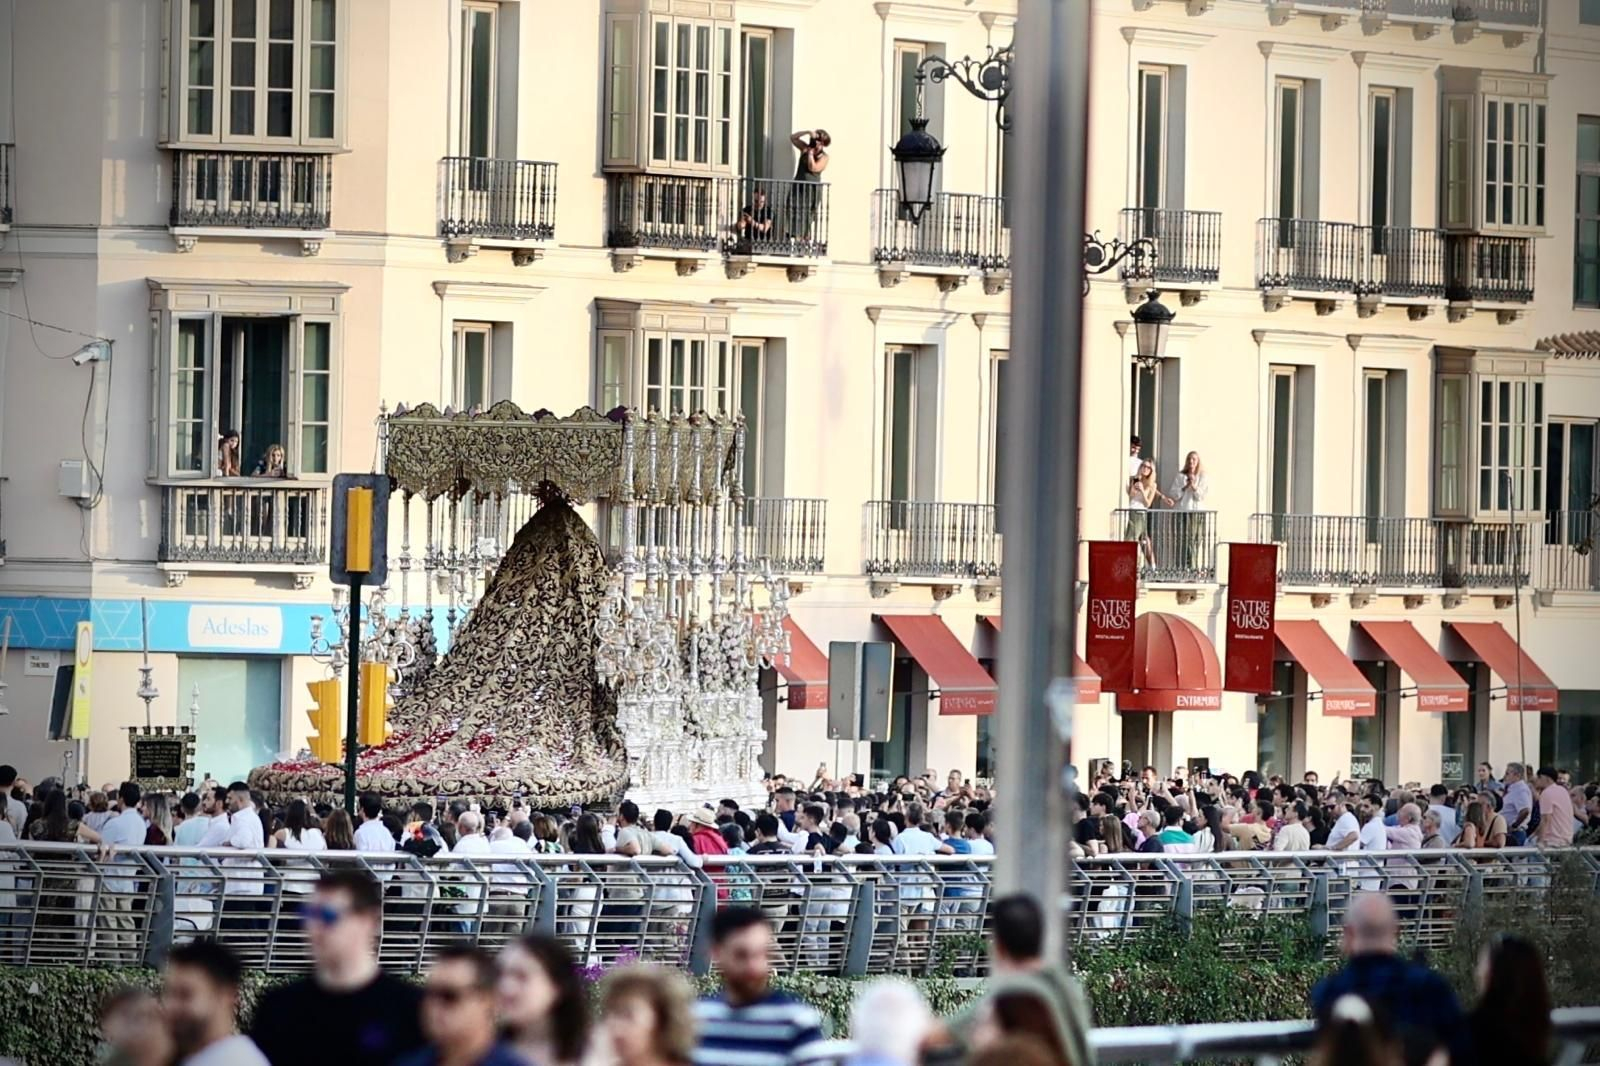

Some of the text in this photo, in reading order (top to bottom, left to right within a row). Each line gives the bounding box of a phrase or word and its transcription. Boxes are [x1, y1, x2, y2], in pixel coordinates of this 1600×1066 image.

[1091, 599, 1131, 615] ENTRE
[1231, 599, 1270, 616] ENTRE
[202, 615, 269, 637] Adeslas
